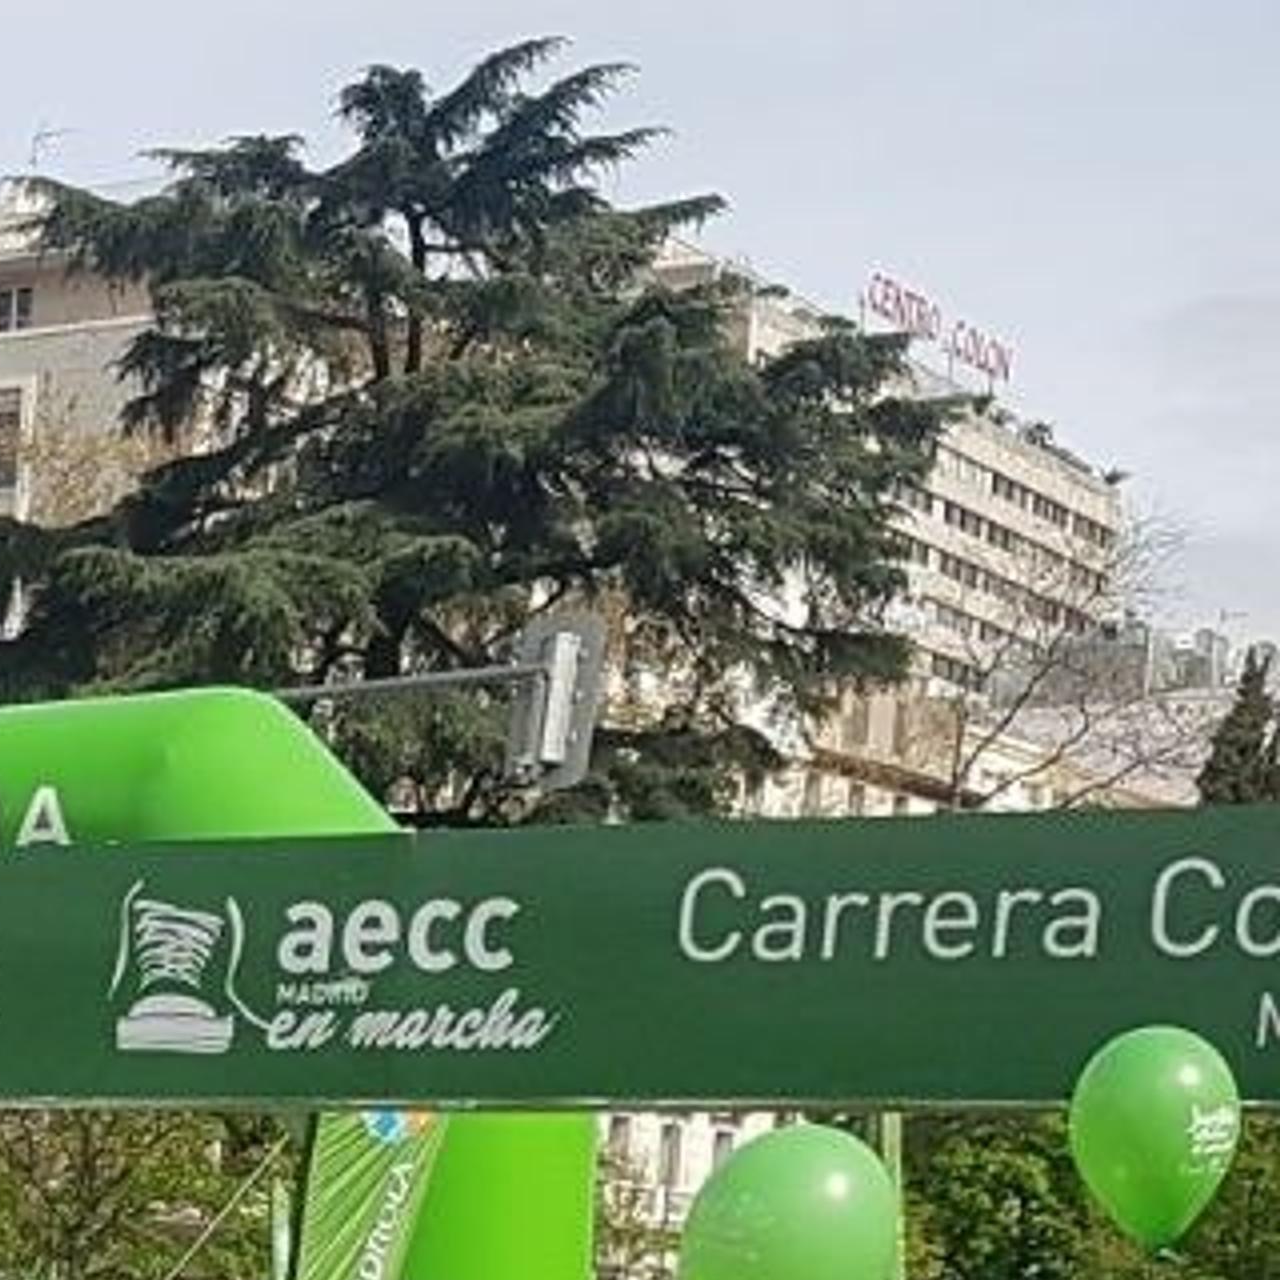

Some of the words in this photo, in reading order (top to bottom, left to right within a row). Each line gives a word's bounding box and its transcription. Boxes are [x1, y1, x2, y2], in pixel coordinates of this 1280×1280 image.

[276, 897, 522, 974] aecc
[678, 867, 1103, 962] Carrera
[266, 1010, 342, 1050] en
[347, 987, 561, 1050] marcha
